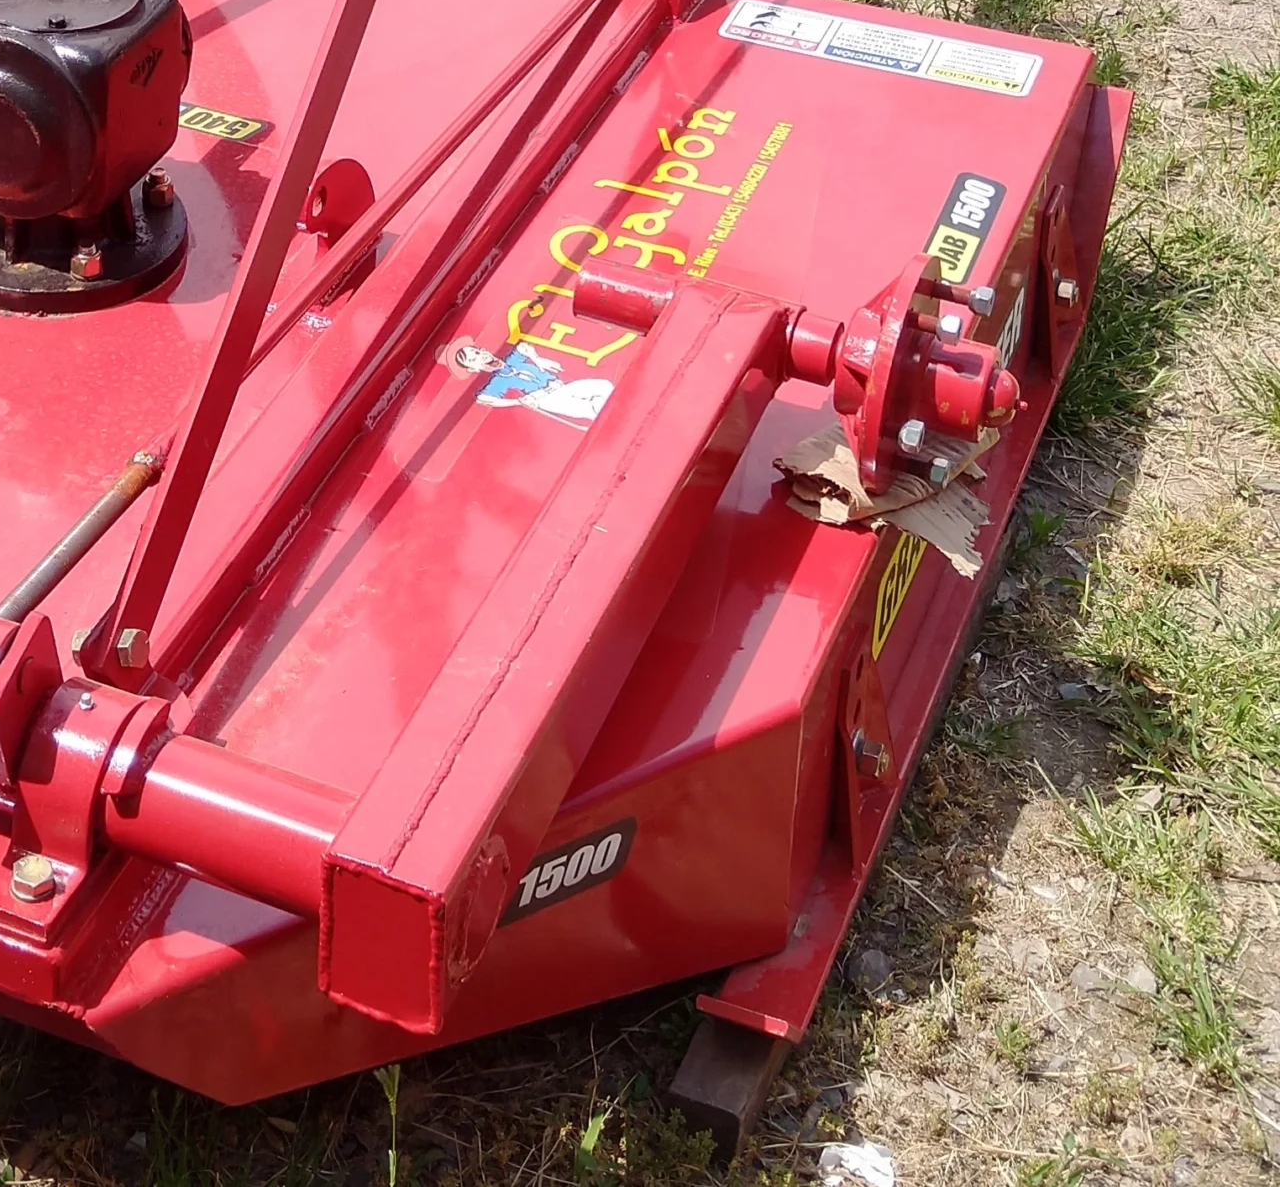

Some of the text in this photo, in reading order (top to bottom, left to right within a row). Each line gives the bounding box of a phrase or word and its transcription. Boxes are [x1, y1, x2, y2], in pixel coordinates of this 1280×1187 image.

[183, 111, 250, 137] 540
[548, 106, 737, 273] Galpón
[937, 178, 997, 272] JAB 1500
[518, 832, 623, 908] 1500
